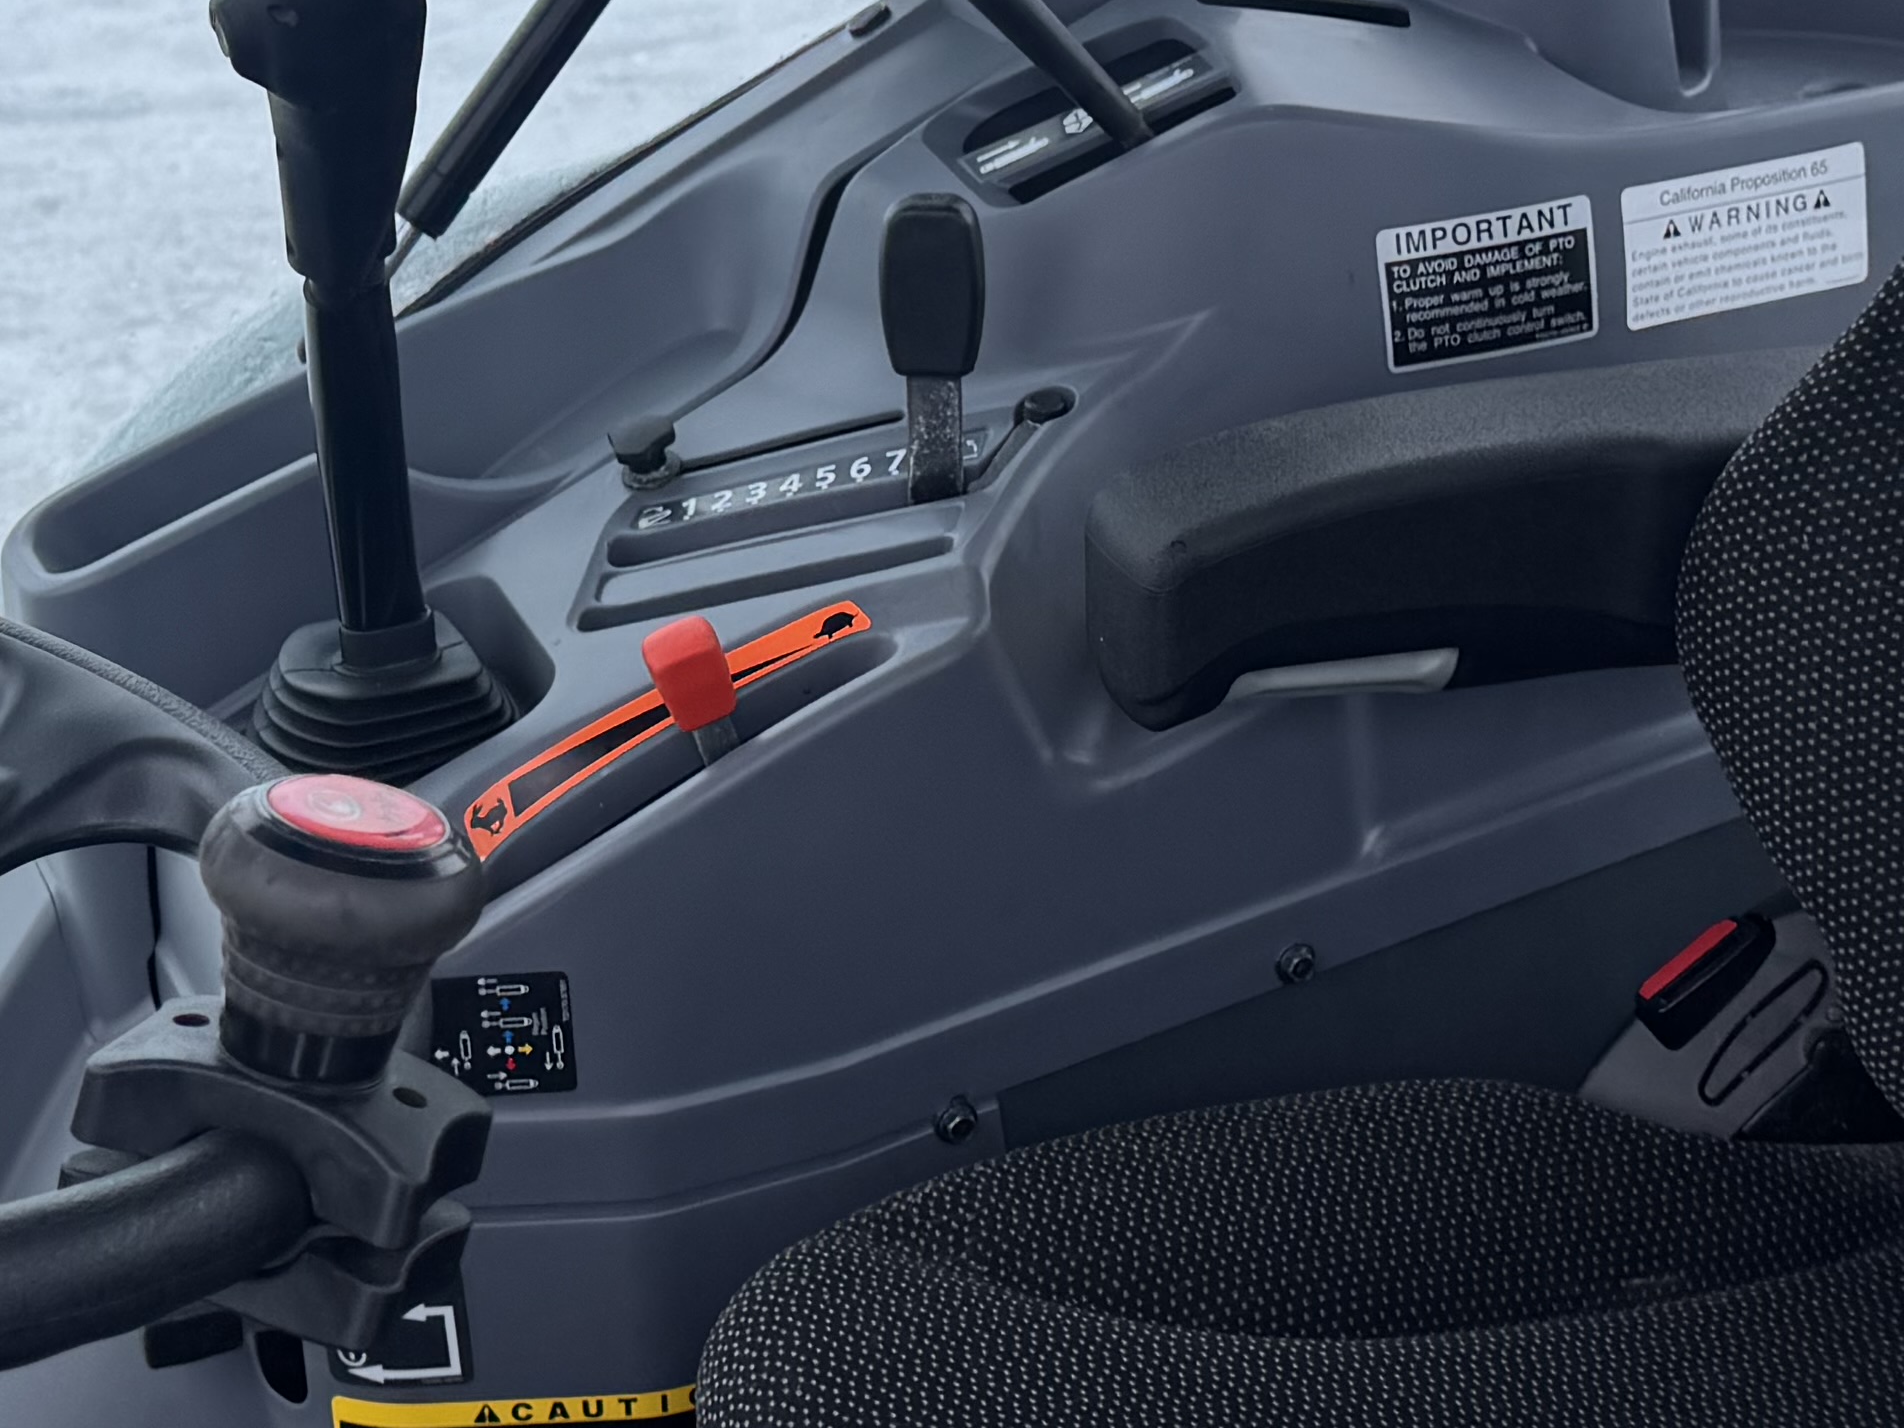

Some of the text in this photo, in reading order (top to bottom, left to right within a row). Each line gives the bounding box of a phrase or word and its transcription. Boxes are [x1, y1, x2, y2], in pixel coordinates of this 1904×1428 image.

[1659, 158, 1829, 207] California Proposition 65
[1396, 203, 1572, 255] IMPORTANT
[1688, 194, 1808, 233] WARNING
[1391, 235, 1576, 280] TO AVOID DAMAGE OF PTO
[1632, 245, 1667, 262] Engine
[1751, 225, 1763, 239] of
[1632, 261, 1667, 277] certain
[1672, 253, 1709, 270] vehicle
[1712, 240, 1776, 262] components
[1780, 234, 1799, 248] and
[1393, 253, 1564, 294] CLUTCH AND IMPLEMENT:
[1632, 276, 1670, 294] contain
[1674, 273, 1686, 285] or
[1715, 255, 1768, 276] chemicals
[1807, 243, 1818, 257] to
[1820, 240, 1837, 254] the
[1663, 288, 1674, 301] of
[1677, 278, 1729, 299] California
[1731, 274, 1743, 288] to
[1405, 293, 1444, 311] Proper
[1450, 287, 1483, 303] warm
[1489, 284, 1504, 299] up
[1510, 279, 1520, 292] is
[1526, 271, 1570, 291] strongly
[1406, 281, 1588, 324] recommended in cold weather.
[1394, 330, 1405, 342] 2.
[1408, 326, 1425, 341] Do
[1431, 322, 1450, 336] not
[1456, 309, 1526, 334] continuously
[1409, 340, 1427, 355] the
[1434, 333, 1461, 349] PTO
[1467, 326, 1501, 344] clutch
[1507, 317, 1545, 337] control
[682, 448, 907, 516] 1 2 3 4 5 6 7
